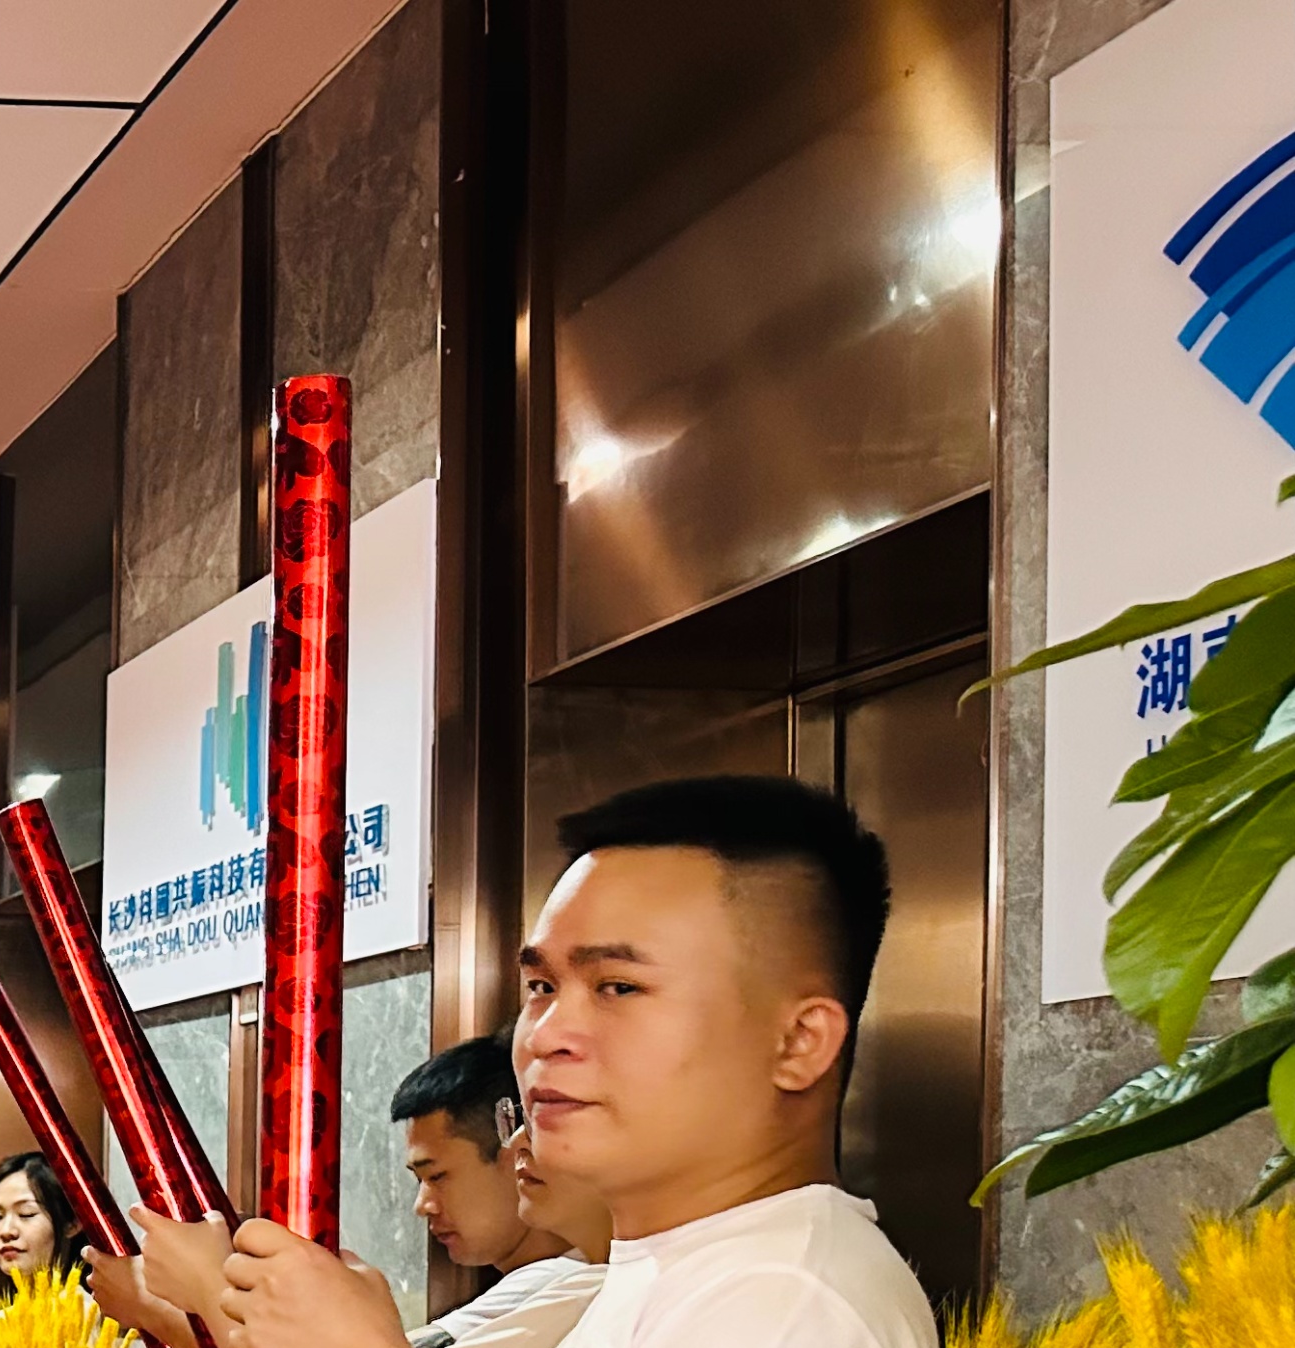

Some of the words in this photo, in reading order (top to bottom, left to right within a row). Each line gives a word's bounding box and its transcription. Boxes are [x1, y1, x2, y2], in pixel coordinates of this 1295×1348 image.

[156, 927, 181, 956] SHA
[188, 914, 217, 946] DOU
[345, 864, 380, 900] HEN
